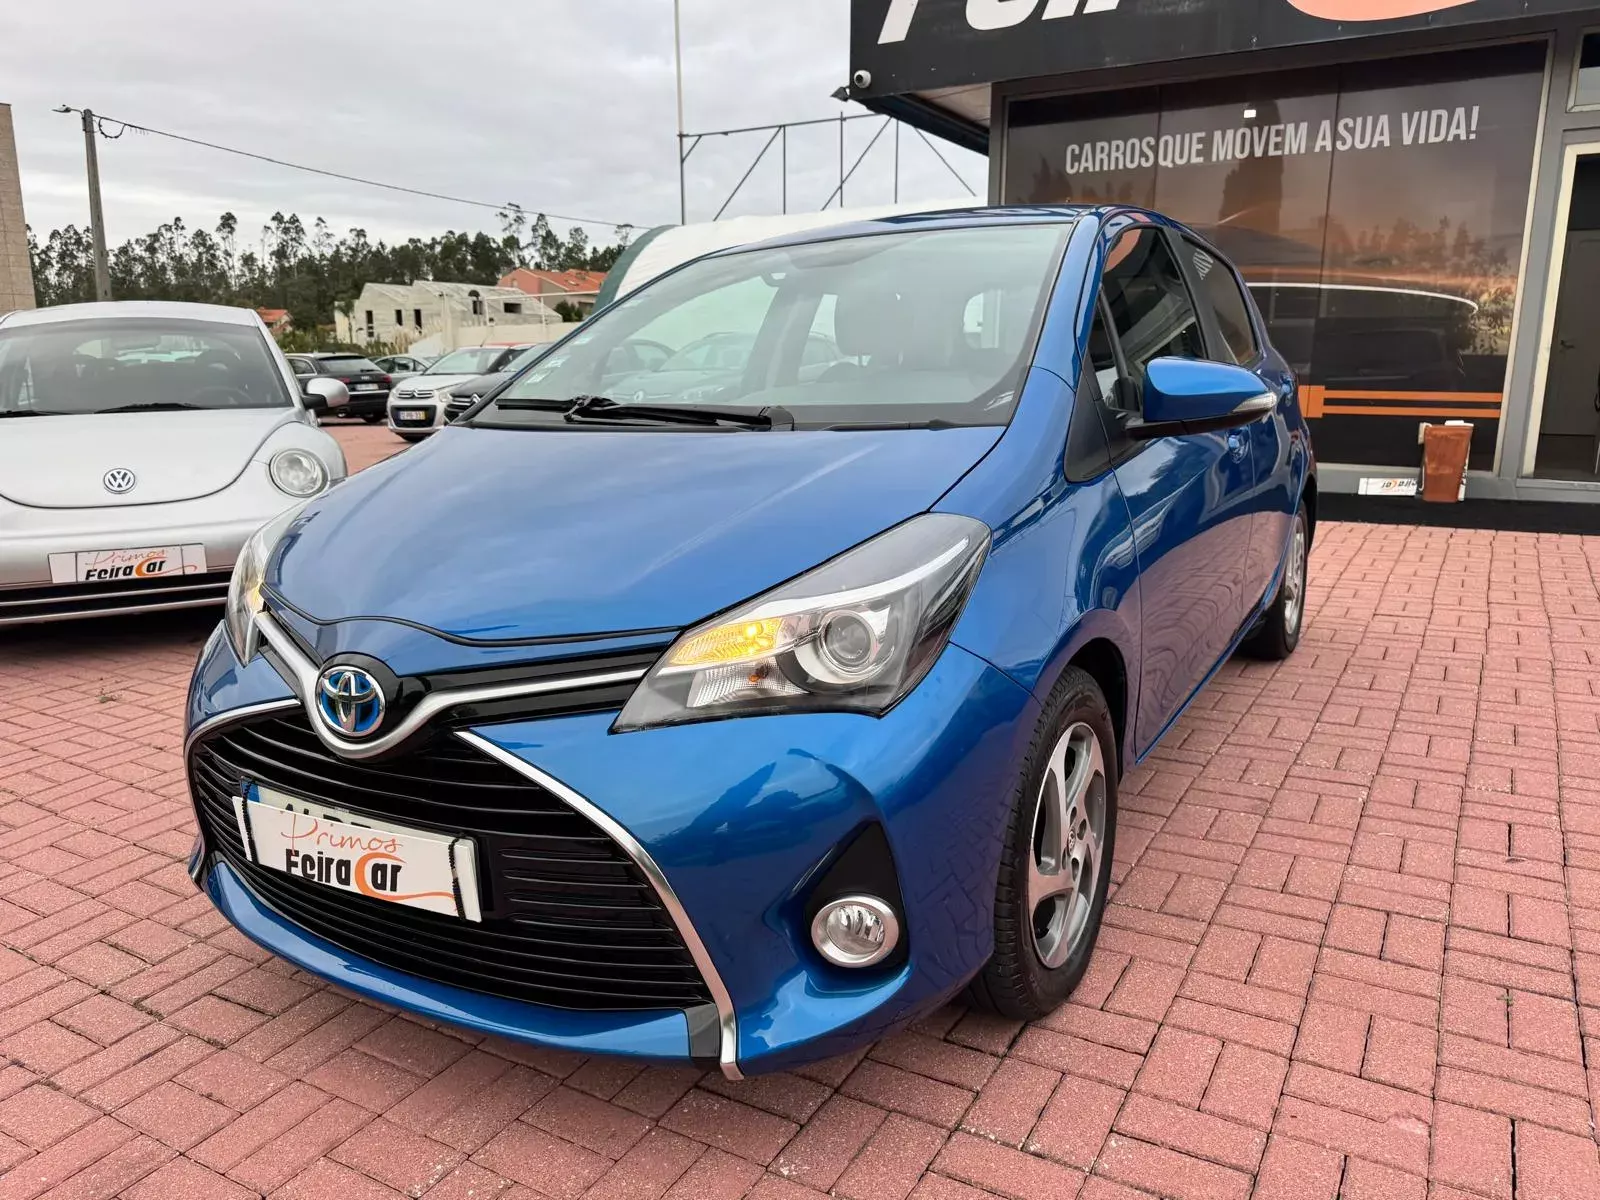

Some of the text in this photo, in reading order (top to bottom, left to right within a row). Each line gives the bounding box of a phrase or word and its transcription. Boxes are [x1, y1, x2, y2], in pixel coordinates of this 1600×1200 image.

[1065, 105, 1480, 174] CARROS QUE MOVEM A SUA VIDA!
[281, 813, 403, 855] Primos
